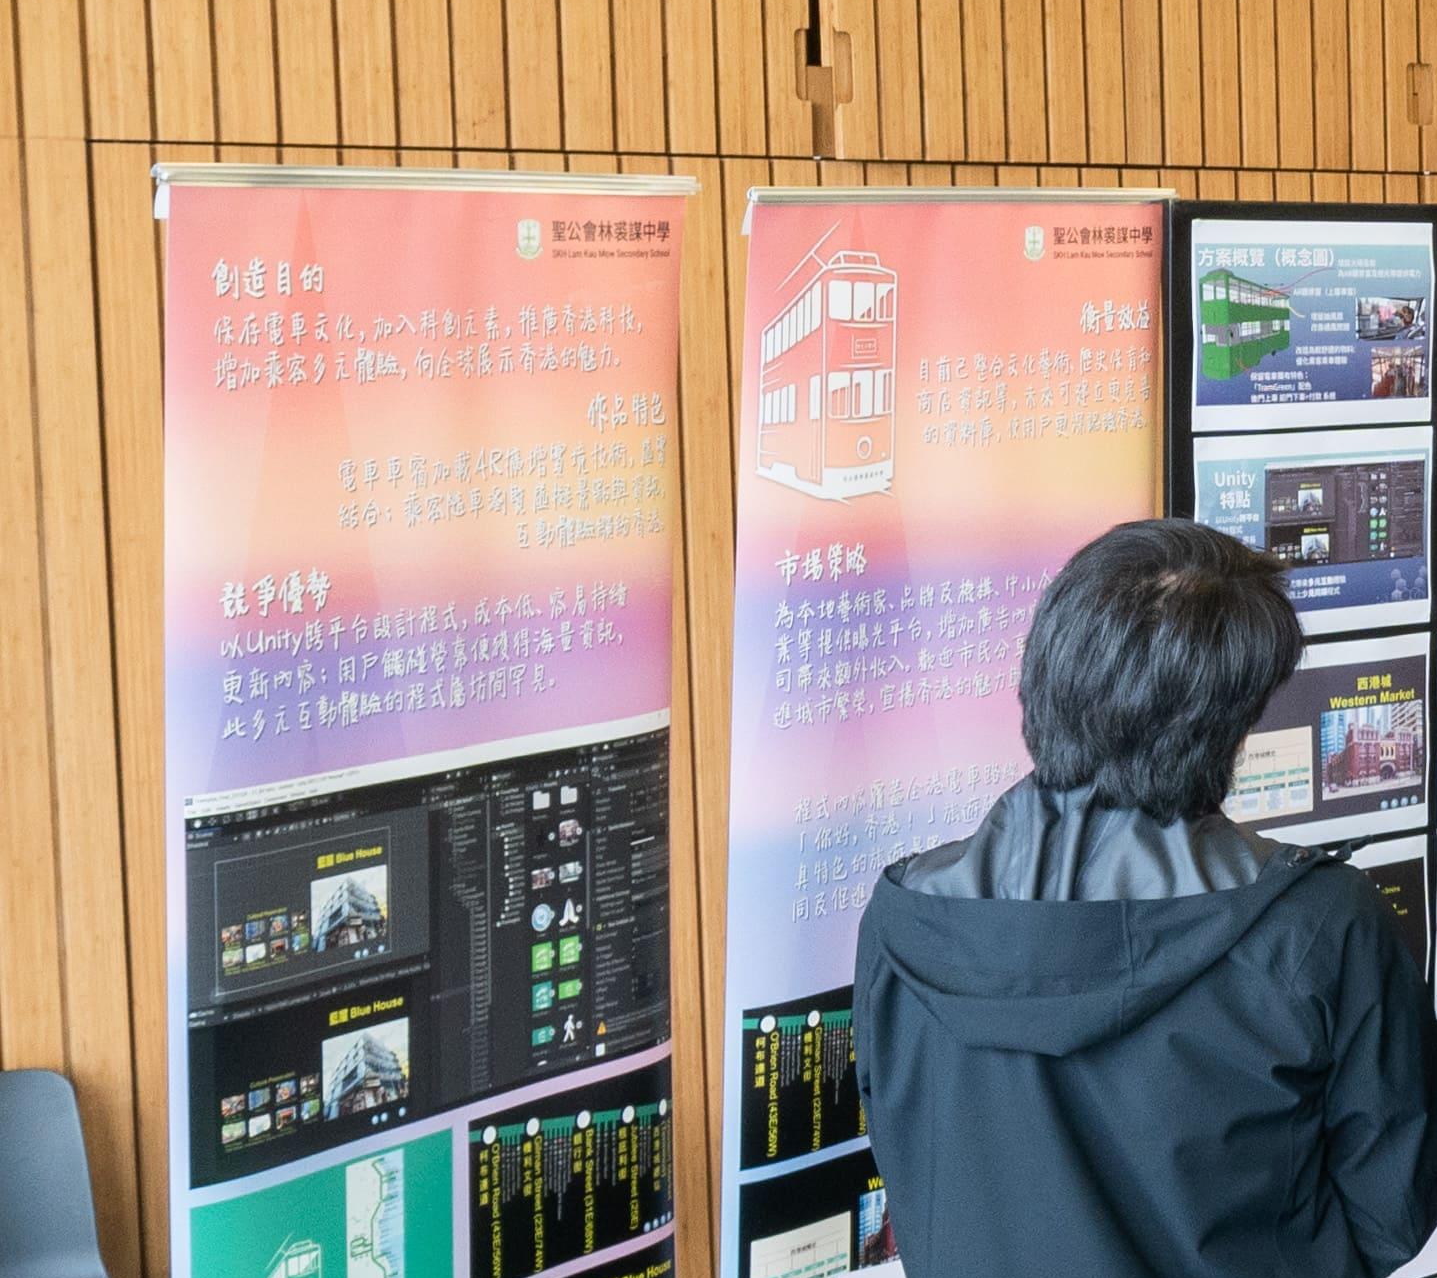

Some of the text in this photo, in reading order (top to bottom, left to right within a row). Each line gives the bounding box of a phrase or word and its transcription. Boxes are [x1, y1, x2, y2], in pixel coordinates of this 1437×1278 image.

[552, 219, 670, 243] 聖公會林裘謀中學
[1053, 226, 1153, 246] 聖公會林裘謀中學
[616, 249, 649, 260] Secondary
[211, 257, 325, 300] 創造目的
[587, 392, 667, 433] 作品特色
[1214, 471, 1256, 488] Unity
[1220, 491, 1250, 509] 特點
[775, 542, 868, 588] 市場策略
[219, 567, 332, 620] 競爭優勢
[1357, 674, 1392, 690] 西港城
[1330, 688, 1415, 710] Western Market
[350, 1003, 371, 1019] Blue
[373, 997, 404, 1011] House
